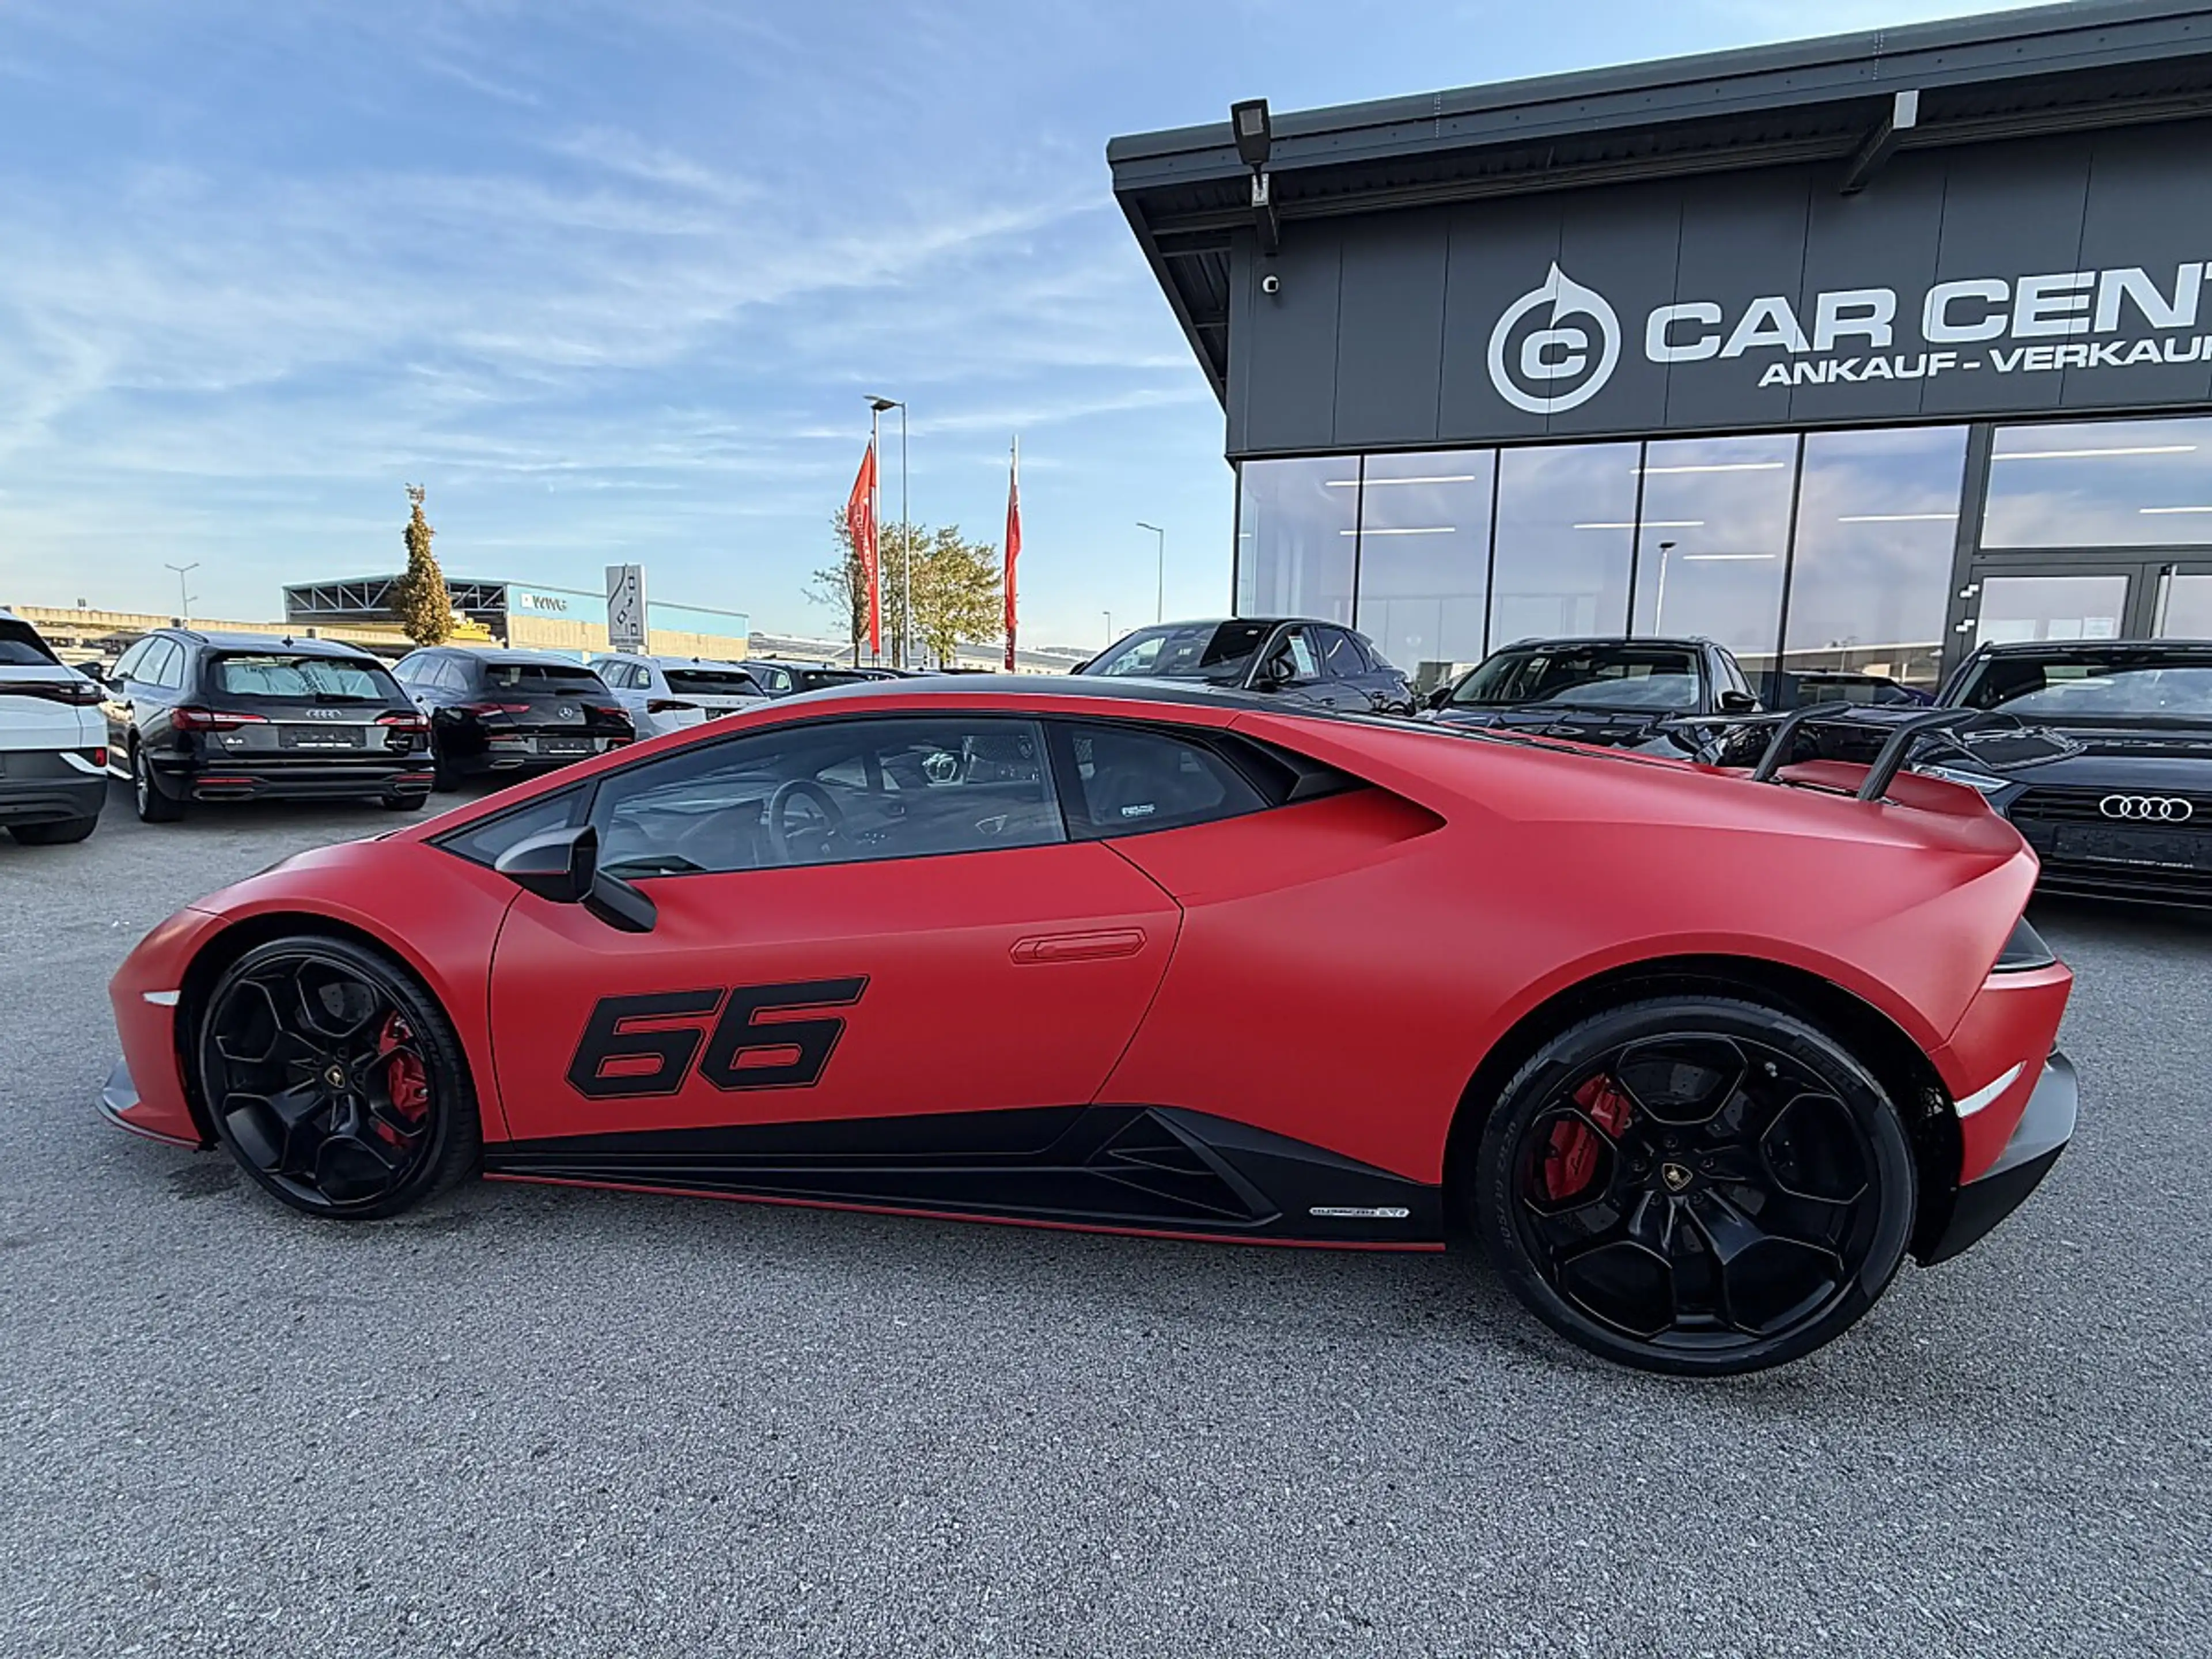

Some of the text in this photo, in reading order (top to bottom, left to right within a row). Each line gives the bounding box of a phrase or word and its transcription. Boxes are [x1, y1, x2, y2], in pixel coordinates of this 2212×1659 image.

[1645, 287, 1897, 363] CAR
[1758, 351, 1958, 387] ANKAUF
[564, 974, 870, 1100] 66
